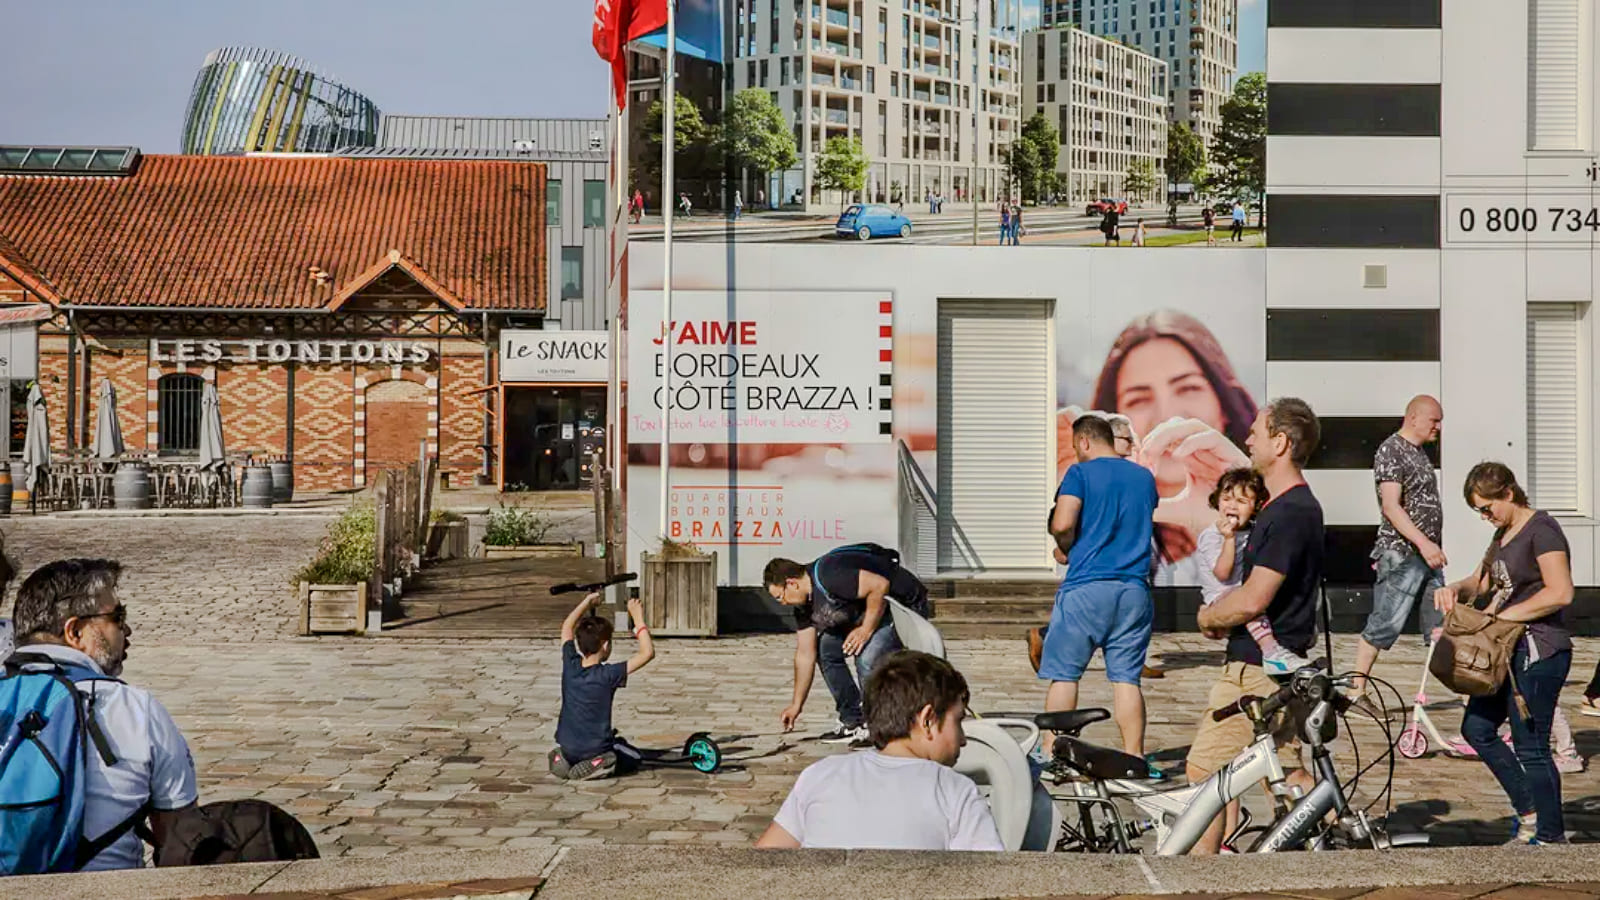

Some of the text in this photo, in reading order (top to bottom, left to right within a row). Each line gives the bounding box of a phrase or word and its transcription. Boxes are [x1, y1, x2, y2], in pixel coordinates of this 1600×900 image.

[1460, 207, 1600, 232] 0 800 734
[150, 338, 430, 362] LES TONTONS
[506, 340, 607, 360] Le SNACK
[655, 353, 820, 378] BORDEAUX
[653, 380, 737, 411] CÔTÉ
[746, 386, 858, 411] BRAZZA
[670, 492, 784, 504] QUARTIER
[670, 506, 784, 517] BORDEAUX
